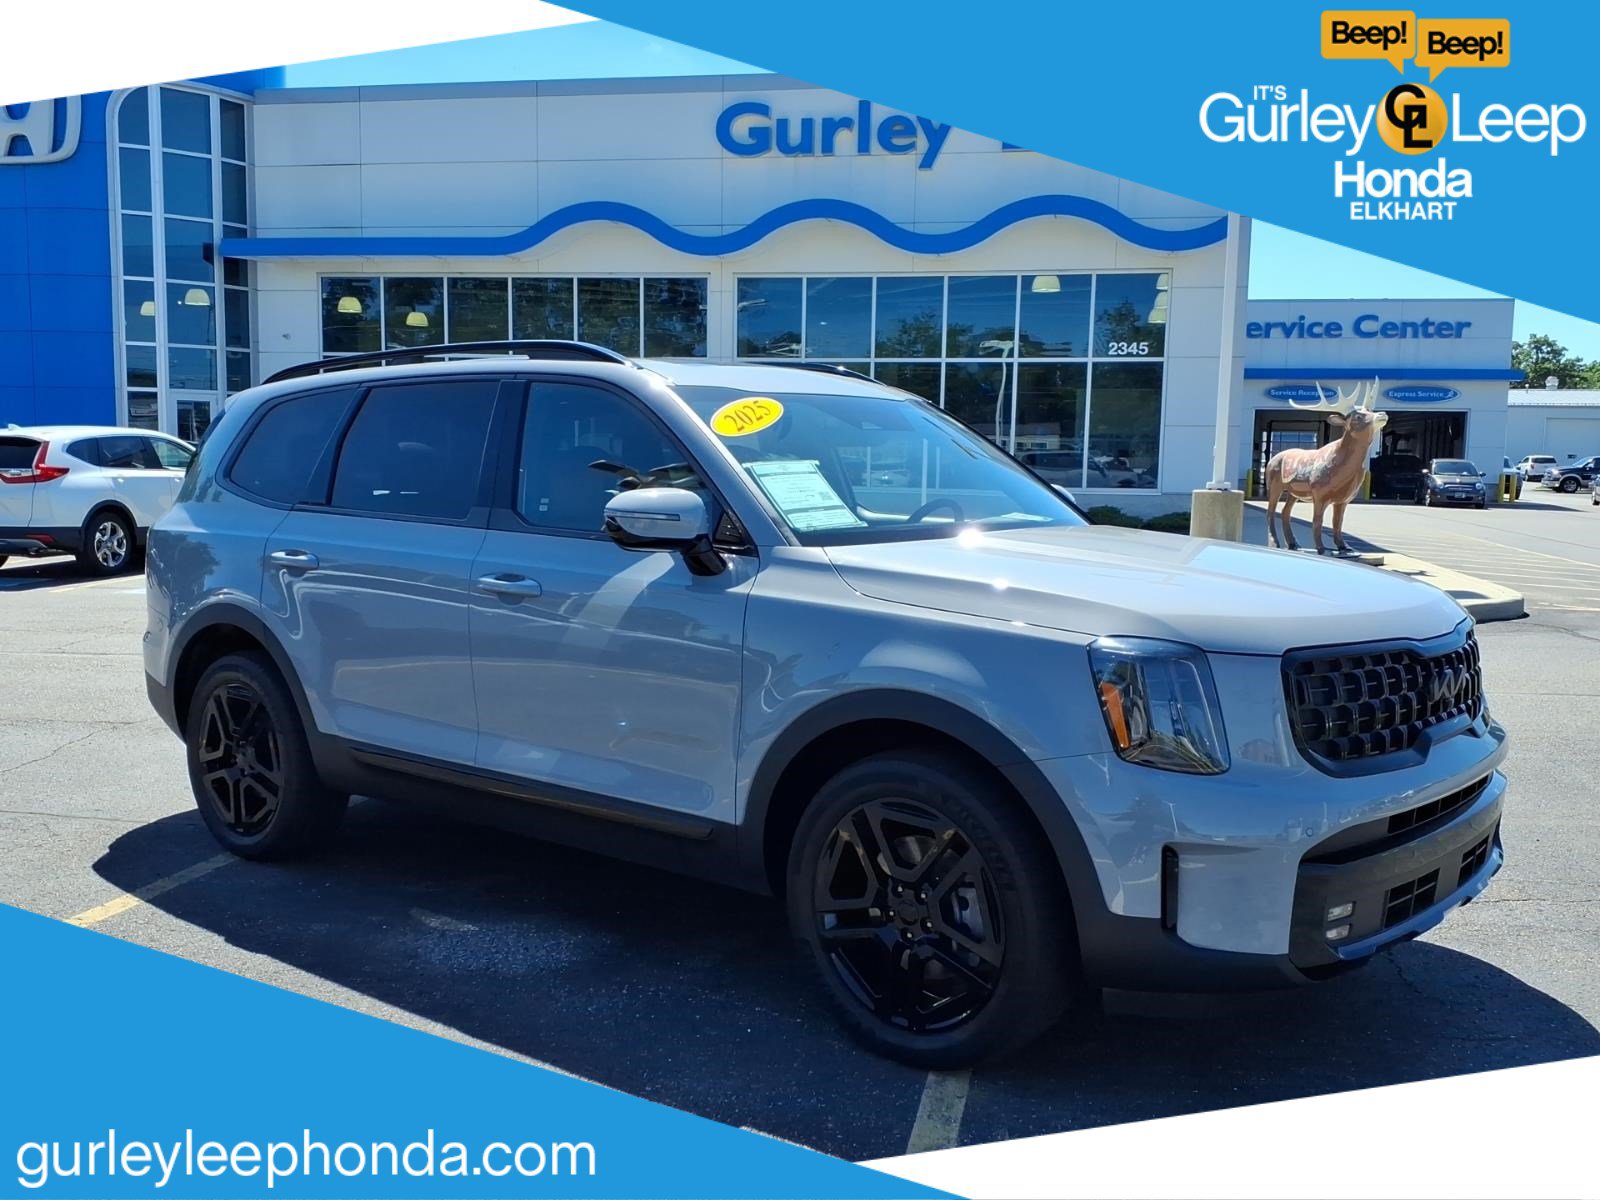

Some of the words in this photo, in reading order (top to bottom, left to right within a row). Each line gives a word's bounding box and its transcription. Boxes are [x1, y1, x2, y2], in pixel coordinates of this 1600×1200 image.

[715, 99, 952, 170] Gurley
[1246, 314, 1343, 339] ervice
[1352, 313, 1473, 339] Center
[1108, 341, 1149, 355] 2345
[1389, 390, 1416, 398] Express
[724, 400, 771, 432] 2025
